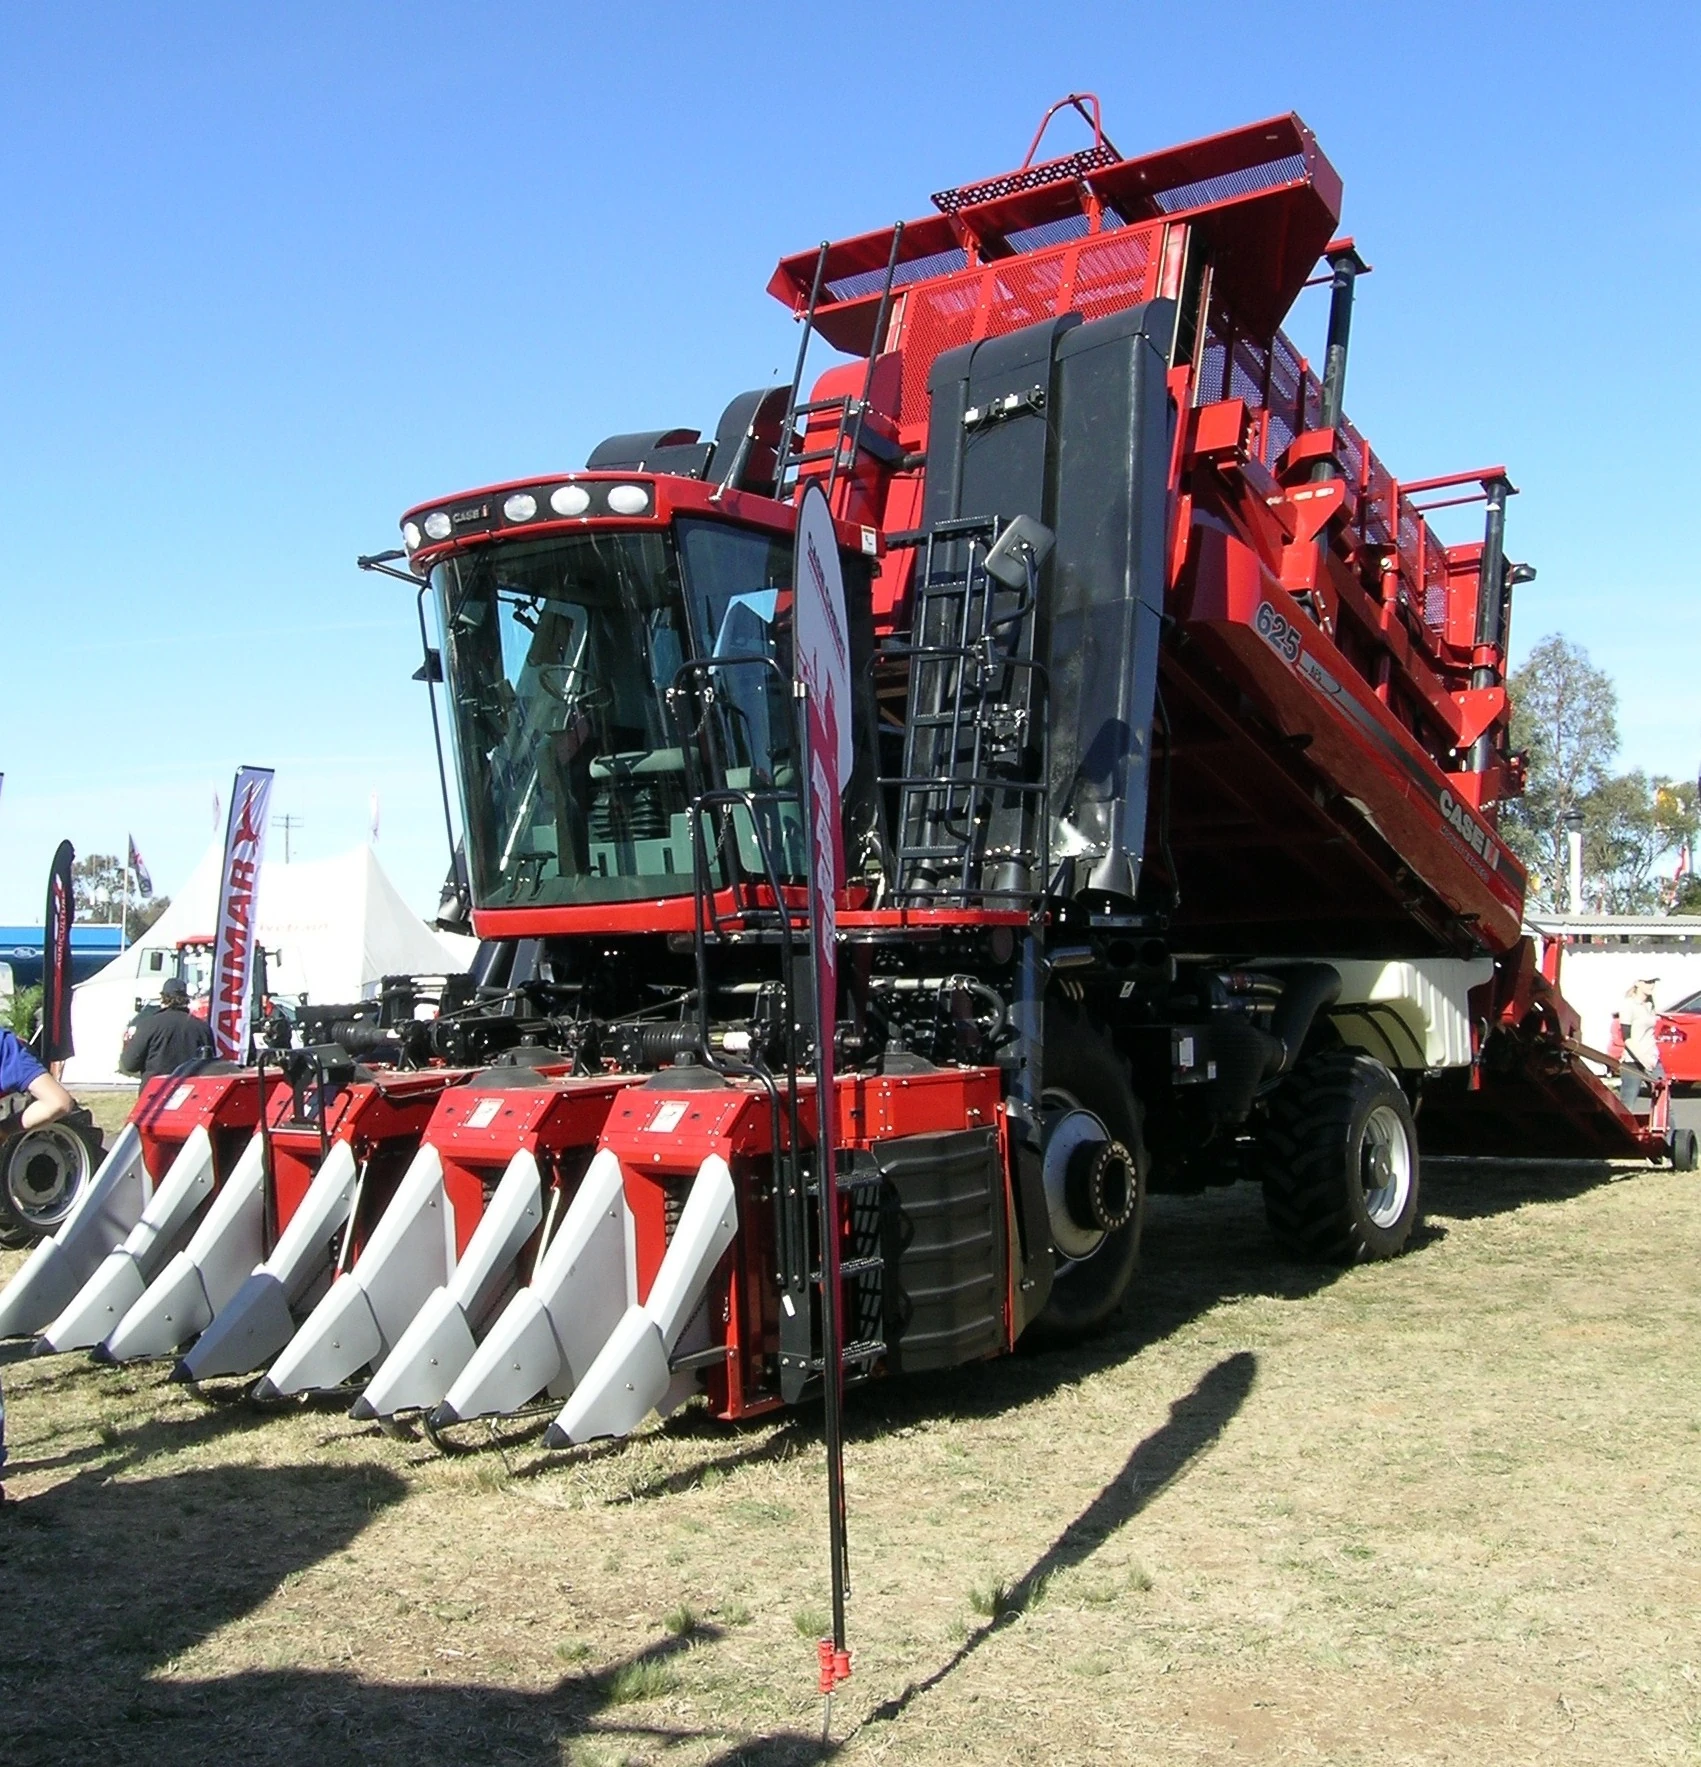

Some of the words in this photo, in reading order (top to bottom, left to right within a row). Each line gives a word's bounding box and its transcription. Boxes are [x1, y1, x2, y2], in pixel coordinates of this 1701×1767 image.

[452, 509, 480, 523] CASE
[1256, 601, 1302, 662] 625
[1440, 789, 1485, 856] CASE
[215, 858, 255, 1061] YANMAR
